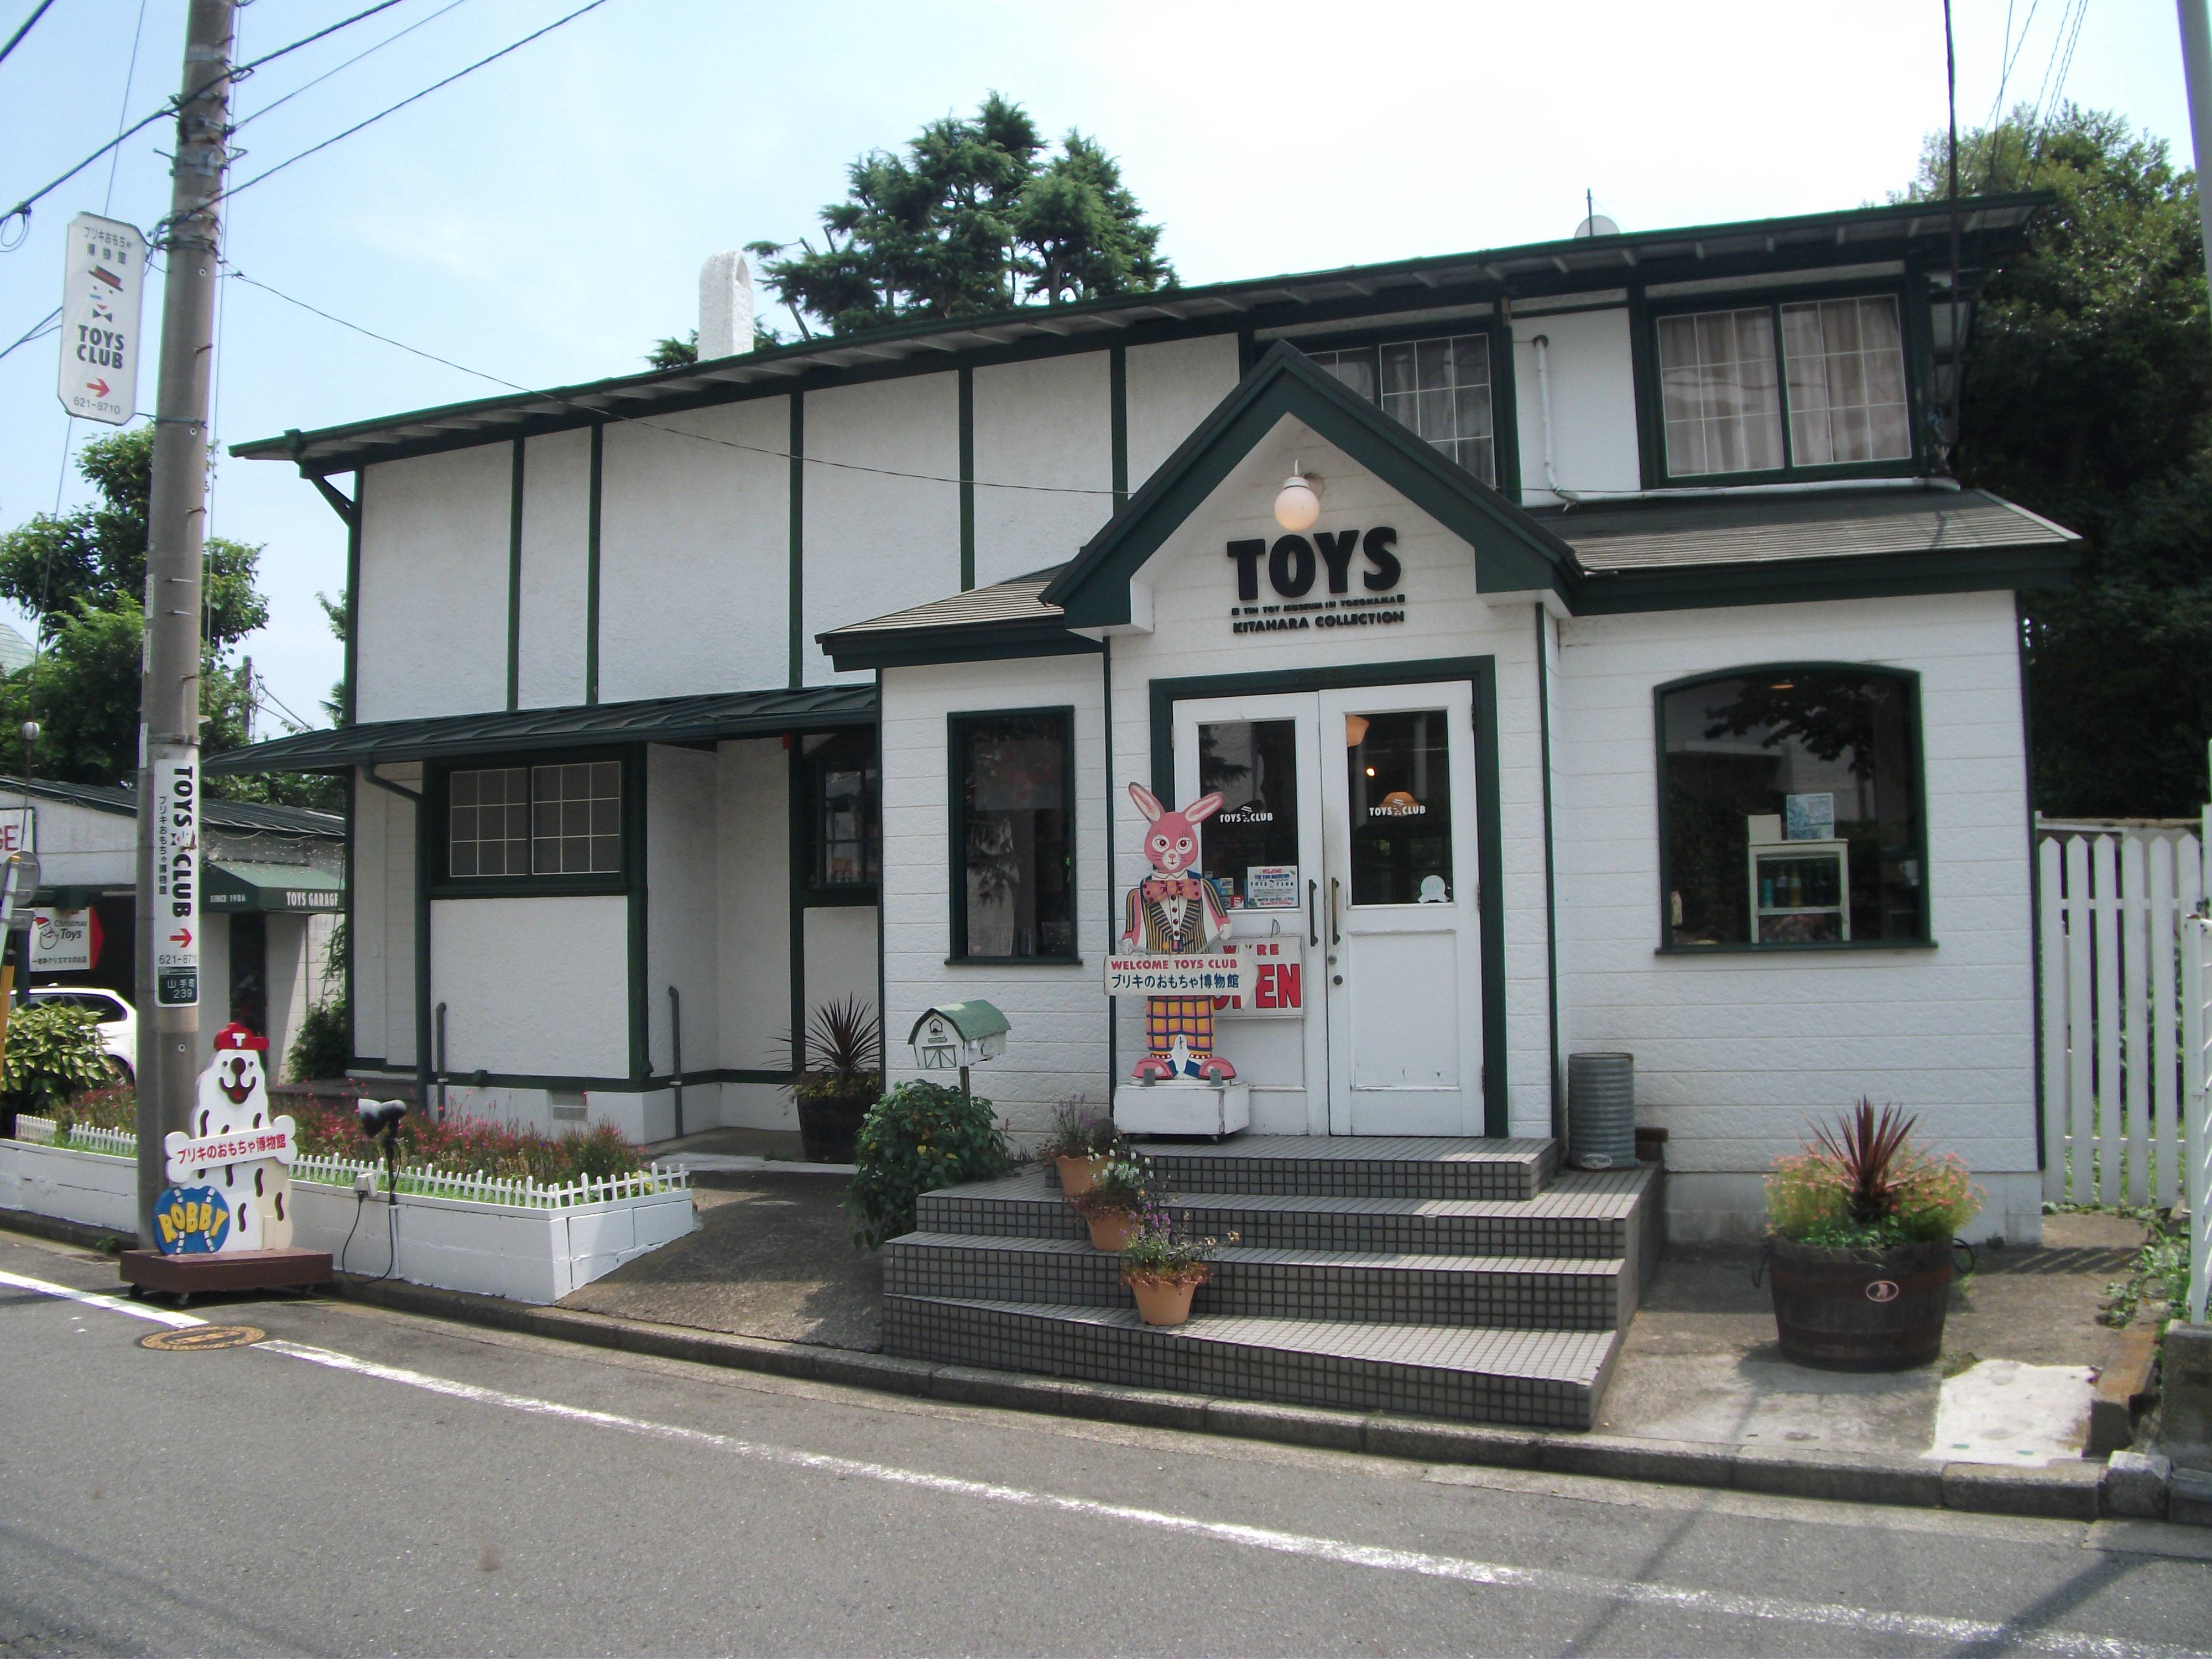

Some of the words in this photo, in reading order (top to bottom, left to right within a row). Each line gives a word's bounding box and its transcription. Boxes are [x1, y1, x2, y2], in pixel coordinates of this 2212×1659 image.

[78, 324, 124, 351] TOYS
[76, 343, 123, 369] CLUB
[74, 397, 121, 415] 621-8710
[1227, 526, 1401, 601] TOYS
[1262, 605, 1280, 614] TOY
[1233, 617, 1310, 633] KITAHARA
[1315, 611, 1405, 628] COLLECTION
[174, 765, 193, 827] TOYS
[1219, 813, 1241, 823] TOYS
[1250, 812, 1273, 822] CLUB
[1369, 807, 1392, 816] TOYS
[1402, 805, 1426, 815] CLUB
[173, 853, 191, 917] CLUB
[229, 894, 246, 902] 1986
[286, 891, 306, 906] TOYS
[60, 928, 82, 941] Toys
[1110, 960, 1168, 970] WELCOME
[1173, 959, 1204, 969] TOYS
[1208, 959, 1238, 969] CLUB
[1112, 973, 1239, 989] ブリキのおもちゃ博物館
[174, 988, 192, 999] 239
[232, 1033, 246, 1047] T
[177, 1134, 286, 1165] ブリキのおもちゃ博物館
[158, 1202, 229, 1244] ROBBY
